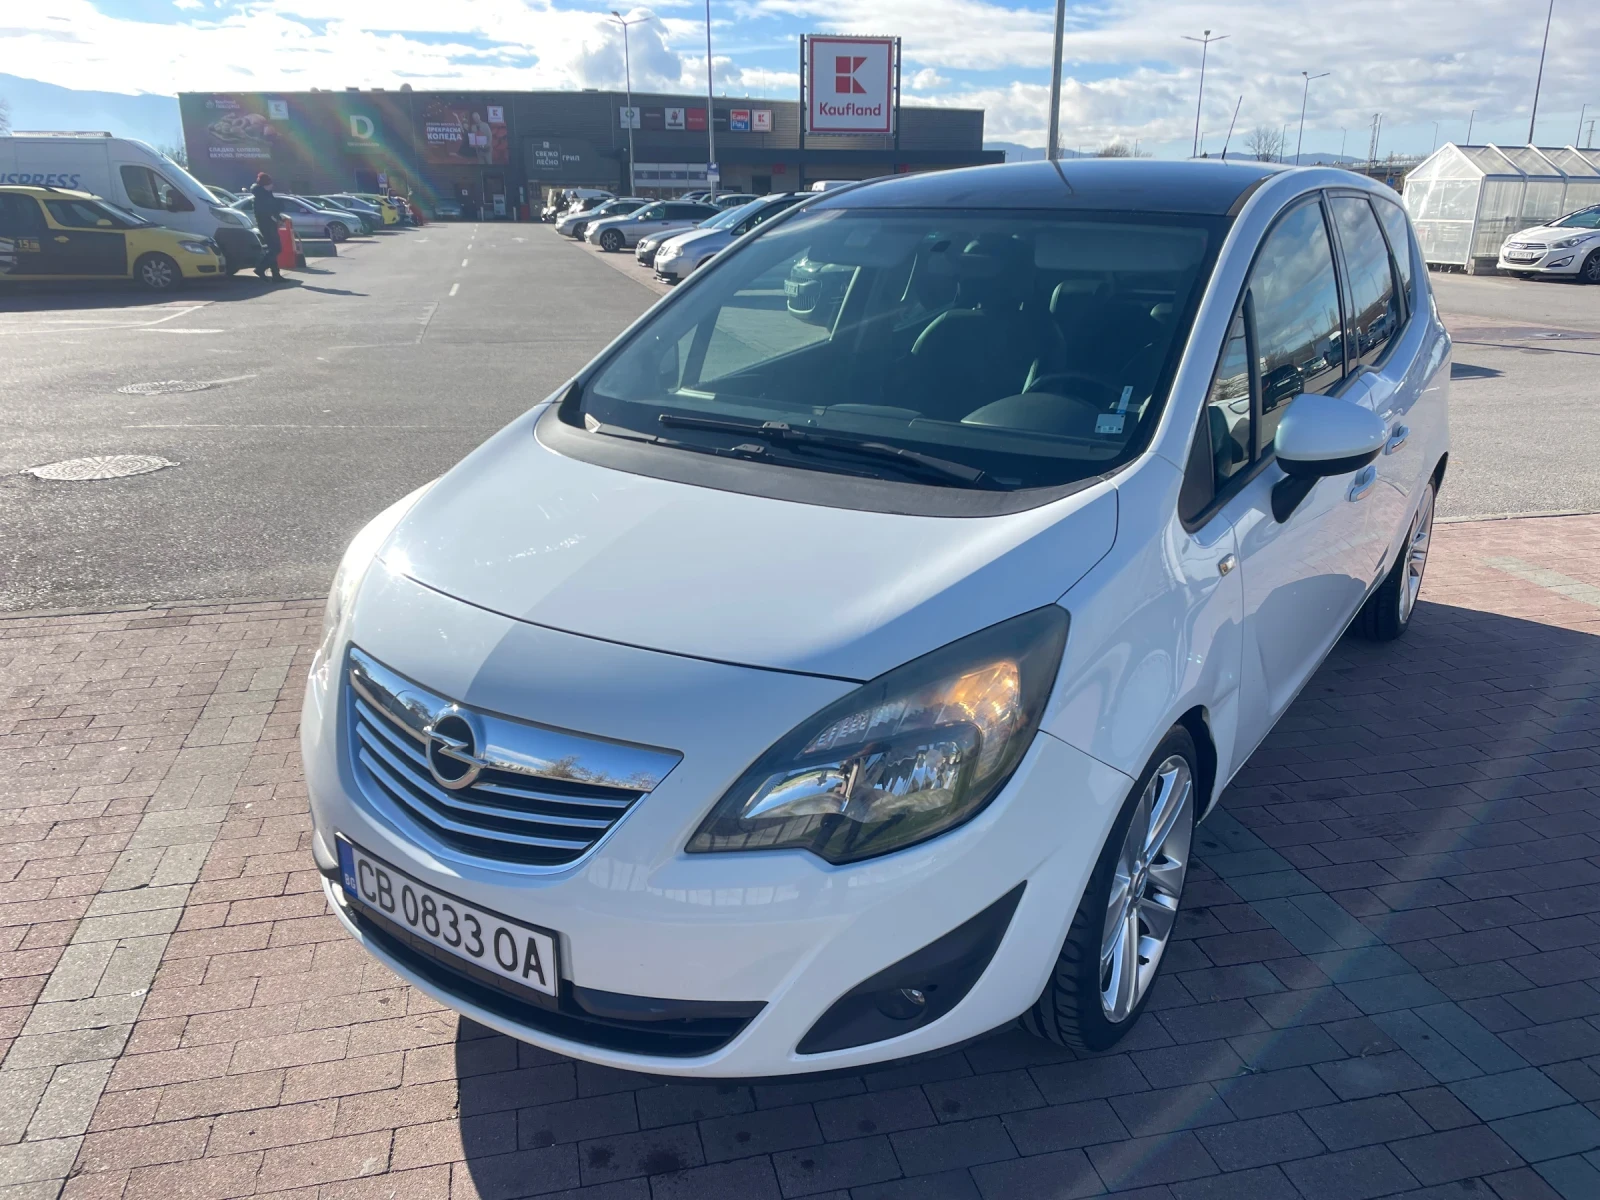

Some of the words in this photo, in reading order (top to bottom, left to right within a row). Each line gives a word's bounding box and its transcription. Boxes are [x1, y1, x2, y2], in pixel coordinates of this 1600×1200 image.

[835, 56, 868, 94] K
[733, 113, 748, 121] Easy
[819, 101, 881, 116] Kaufland
[349, 115, 374, 139] D
[344, 873, 356, 890] BG
